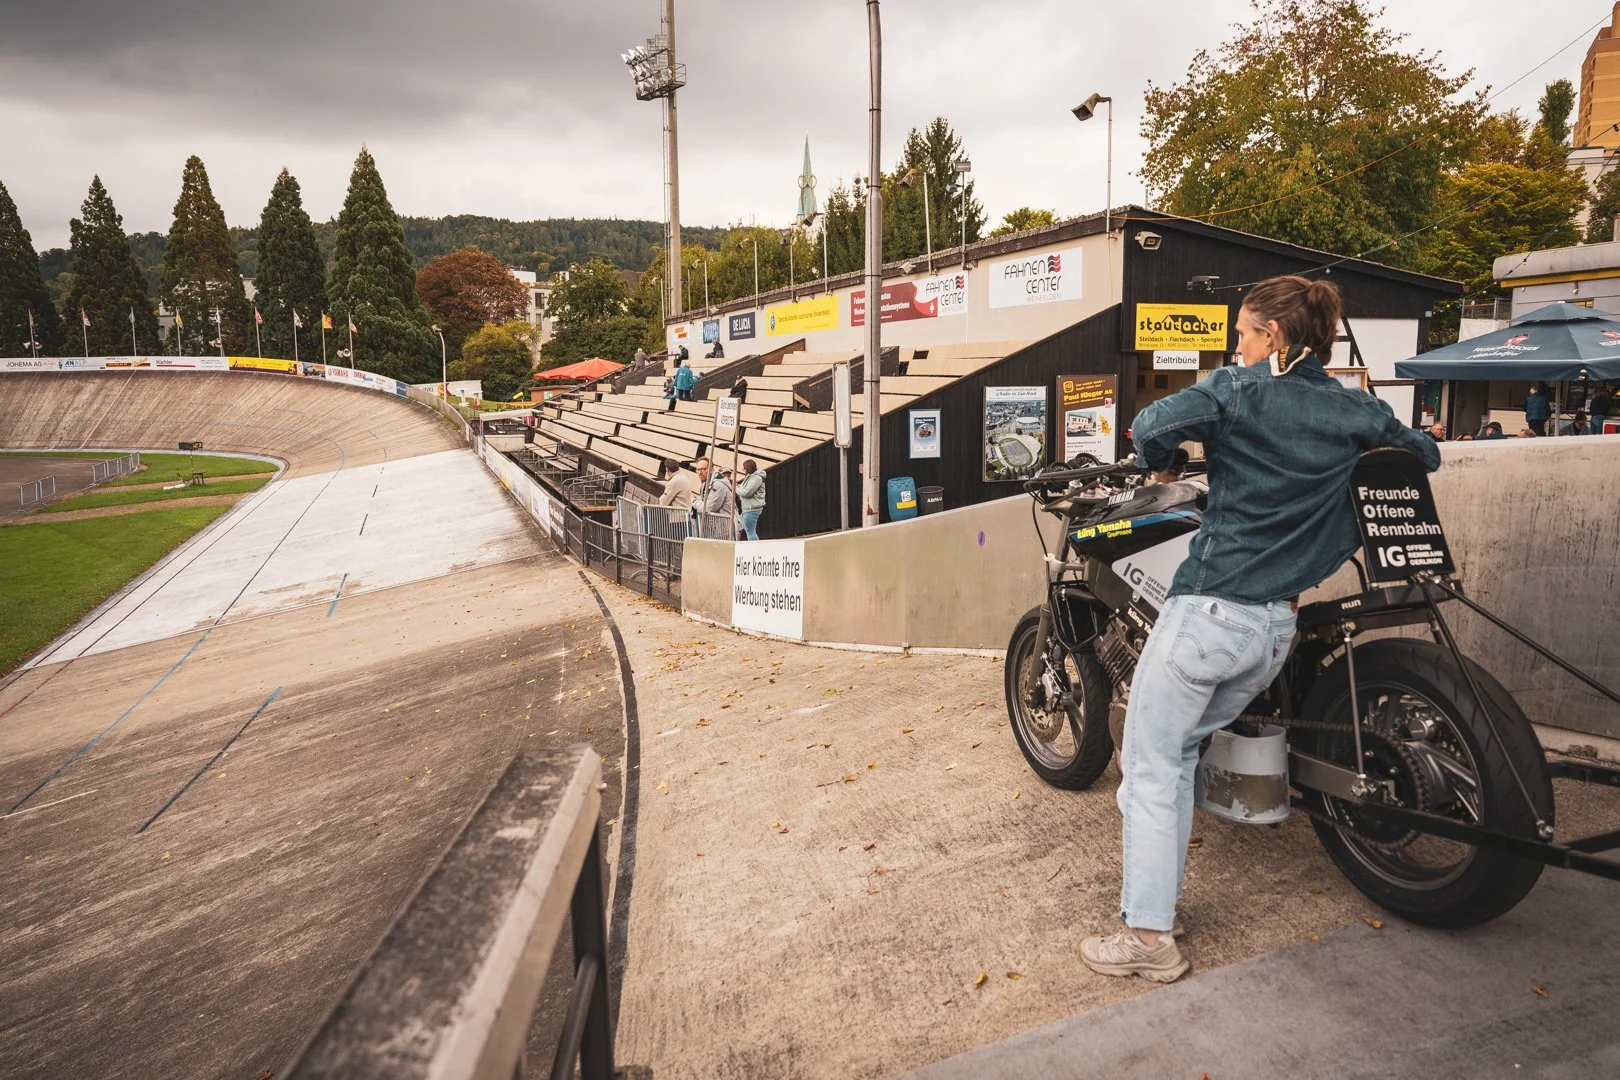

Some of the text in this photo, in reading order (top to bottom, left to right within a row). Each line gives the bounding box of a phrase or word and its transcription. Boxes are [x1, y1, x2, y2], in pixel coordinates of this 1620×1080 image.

[1004, 259, 1046, 280] FAHNEN
[925, 278, 955, 294] FAHNEN
[1026, 275, 1062, 294] CENTER
[940, 291, 965, 306] CENTER
[1139, 316, 1224, 332] staudacher
[1156, 355, 1197, 364] Zieltribüne
[1063, 393, 1080, 402] Paul
[1107, 489, 1136, 506] YAMAHA
[1357, 486, 1420, 501] Freunde
[1363, 504, 1416, 519] Offene
[1096, 519, 1132, 534] Yamaha
[1366, 521, 1442, 537] Rennbahn
[1405, 543, 1432, 552] OFFENE
[1407, 550, 1444, 559] RENNBAHN
[1377, 545, 1407, 568] IG
[1409, 557, 1443, 566] OERLIKON
[735, 555, 800, 578] Hier könnte ihre
[1122, 562, 1145, 586] IG
[1144, 581, 1165, 598] RENNBA
[1147, 575, 1168, 593] OFFENE
[734, 584, 801, 614] Werbung stehen
[1127, 607, 1144, 628] küng
